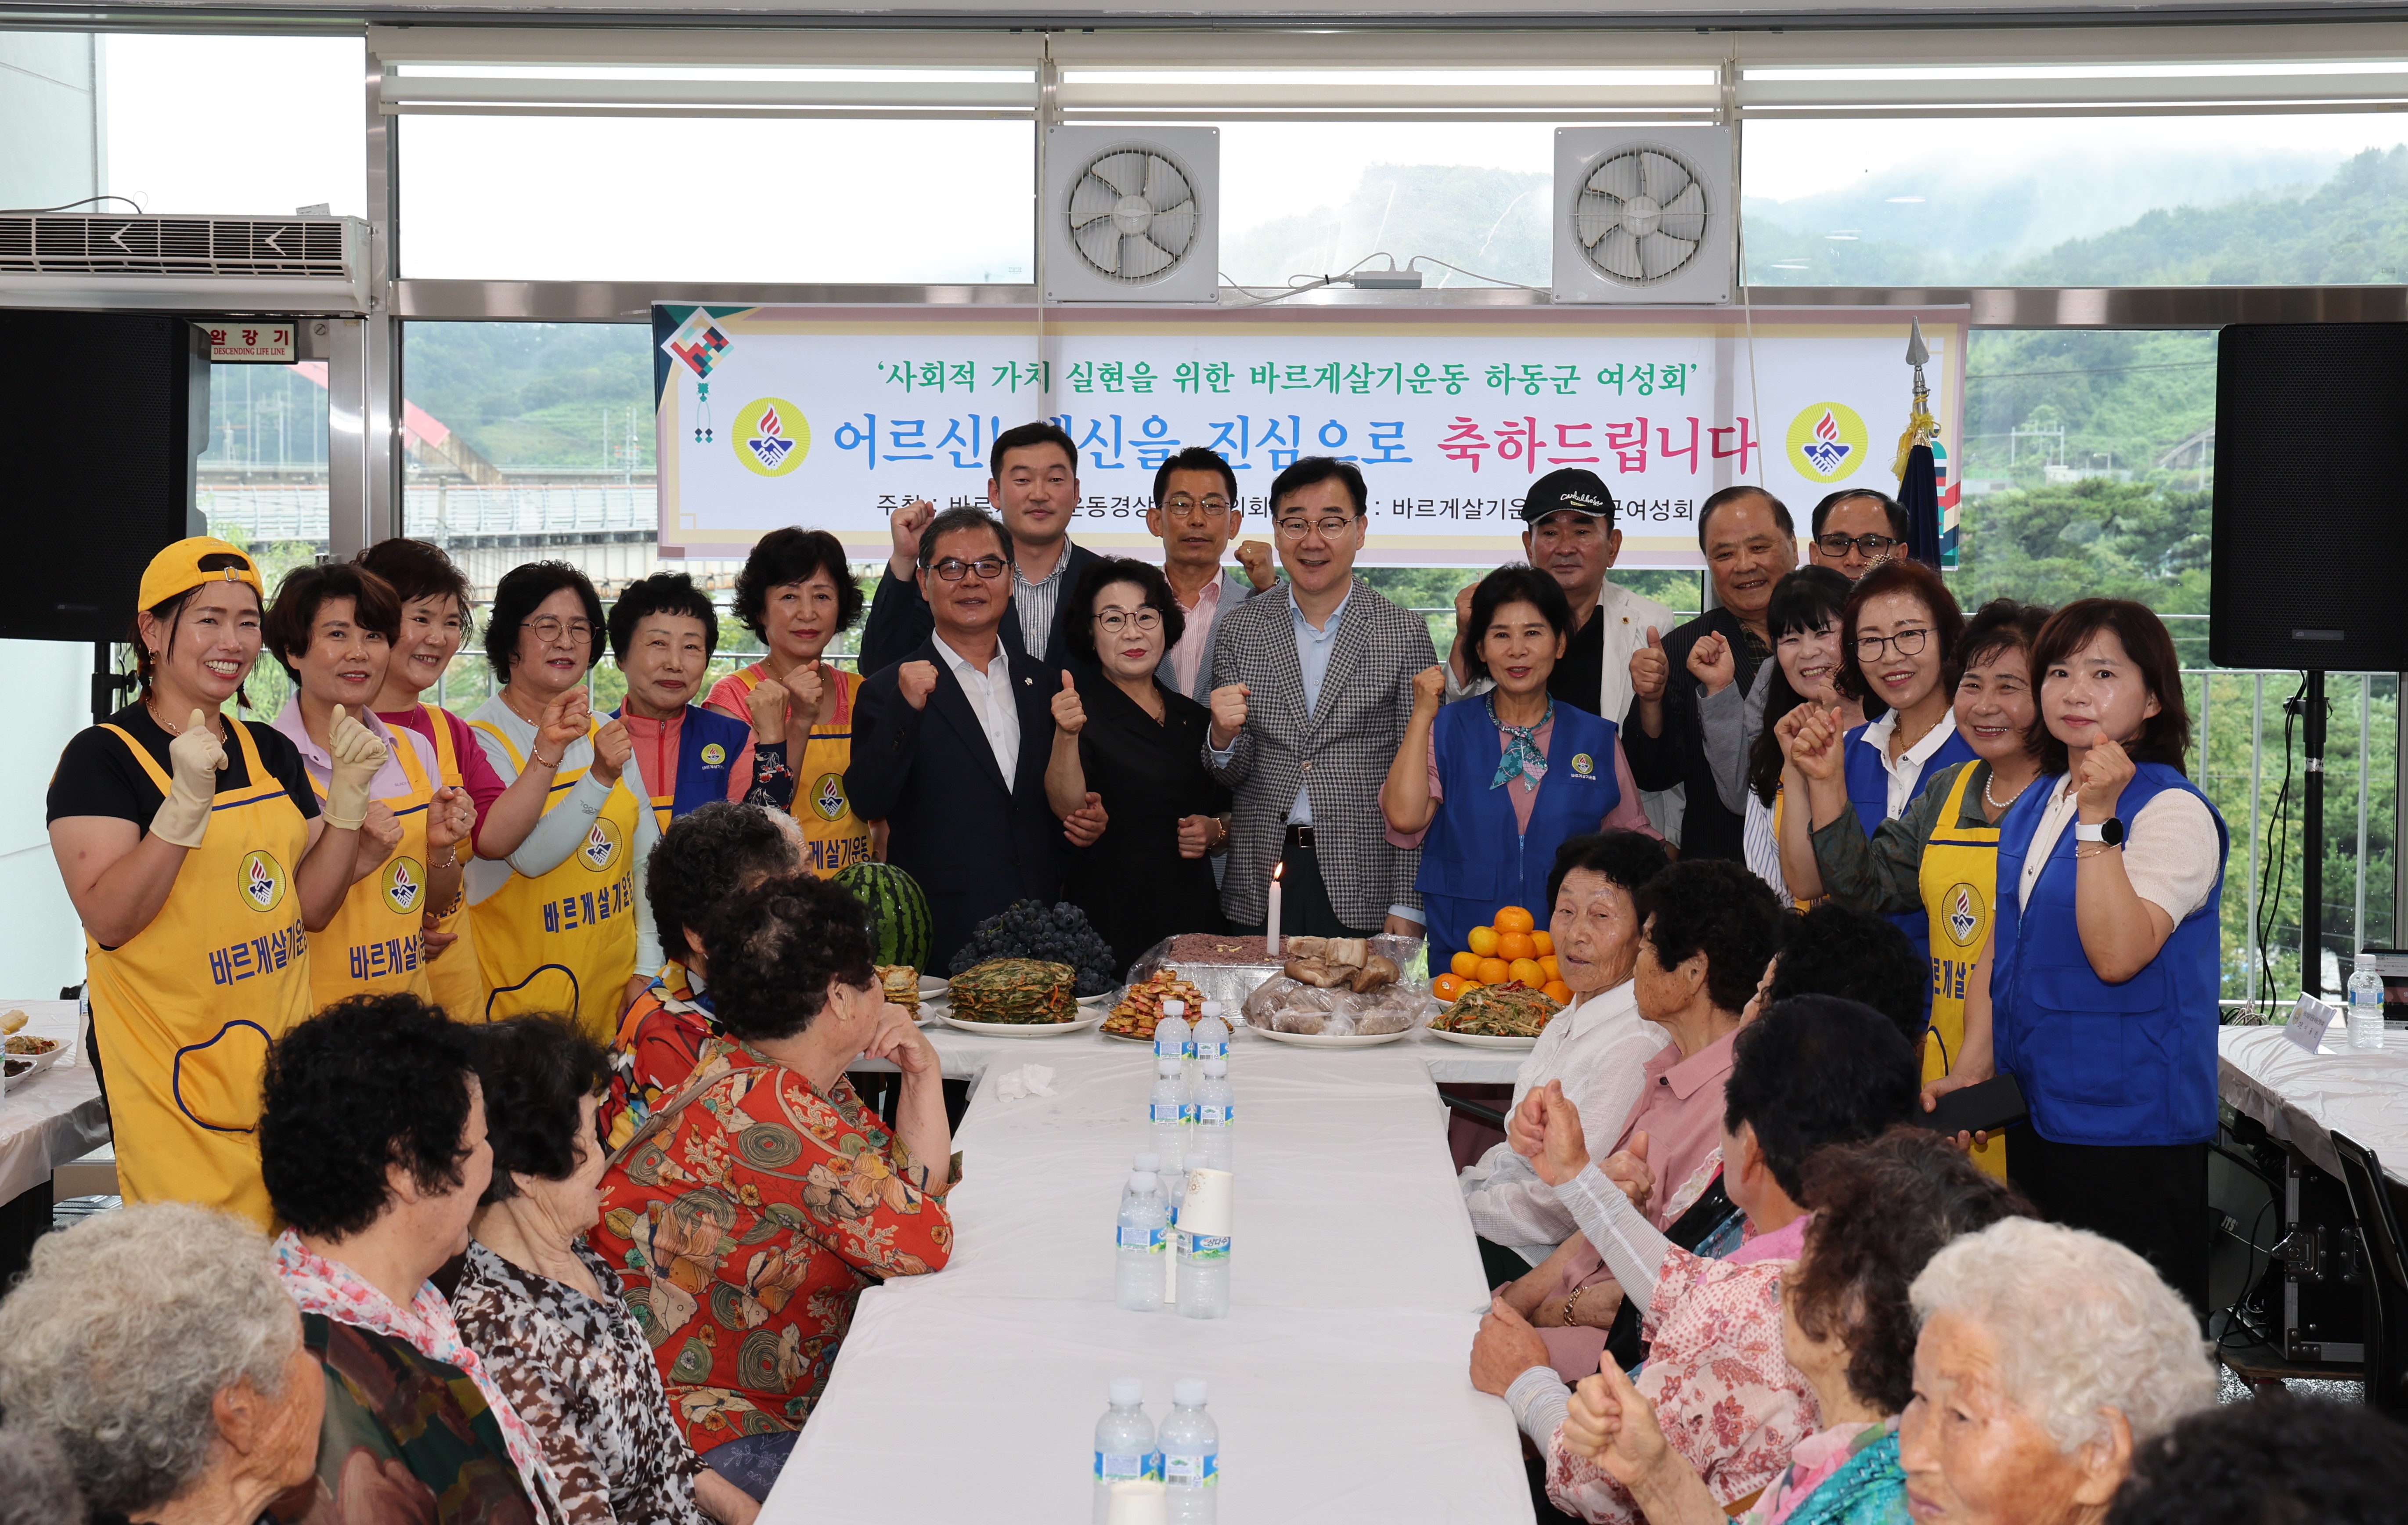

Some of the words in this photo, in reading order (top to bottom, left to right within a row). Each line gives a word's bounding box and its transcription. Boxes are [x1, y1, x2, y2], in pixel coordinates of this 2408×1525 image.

[993, 361, 1049, 394] 가치
[1066, 361, 1158, 393] 실현을
[1173, 361, 1235, 394] 위한
[1250, 361, 1470, 396] 바르게살기운동
[1485, 363, 1582, 396] 하동군
[835, 414, 1000, 471] 어르신!
[1037, 415, 1182, 470] 신을
[1208, 415, 1413, 472] 진심으로
[1438, 416, 1758, 475] 축하드립니다
[808, 835, 871, 870] 게살기운동
[543, 870, 633, 934] 바르게살기운동
[1932, 957, 1976, 1000] 르게살
[2221, 1215, 2237, 1231] JTS
[1207, 1237, 1228, 1247] 삼다수
